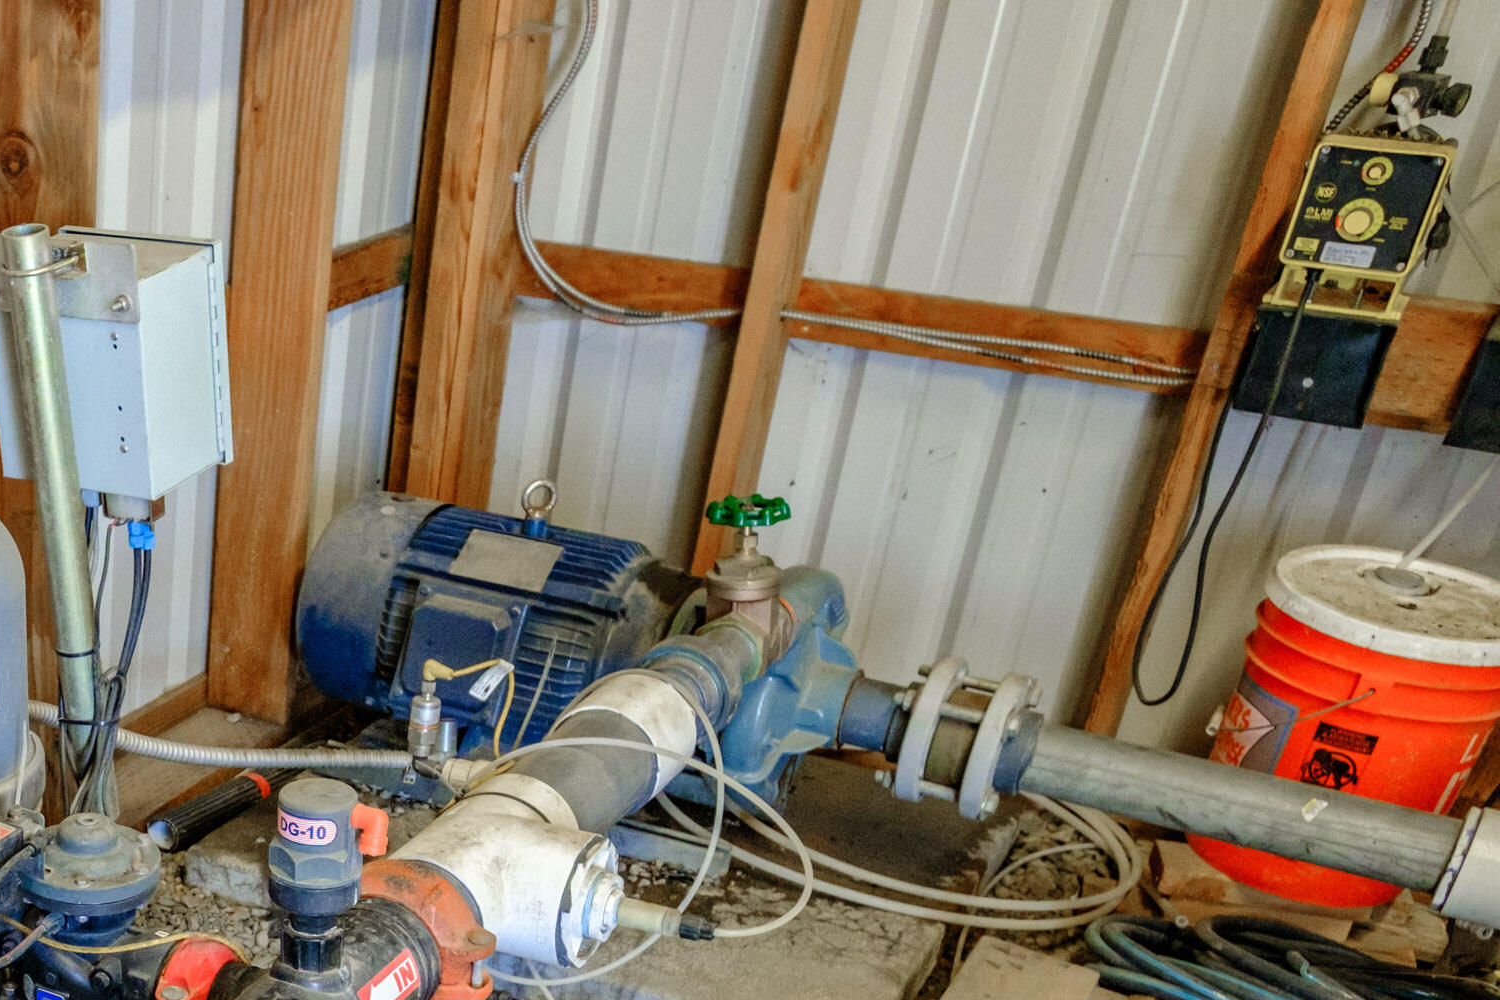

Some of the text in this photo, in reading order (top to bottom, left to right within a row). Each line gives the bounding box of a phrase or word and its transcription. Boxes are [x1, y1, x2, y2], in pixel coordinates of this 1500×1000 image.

[1317, 187, 1335, 198] NSF
[280, 816, 327, 840] DG-10
[392, 960, 416, 993] IN
